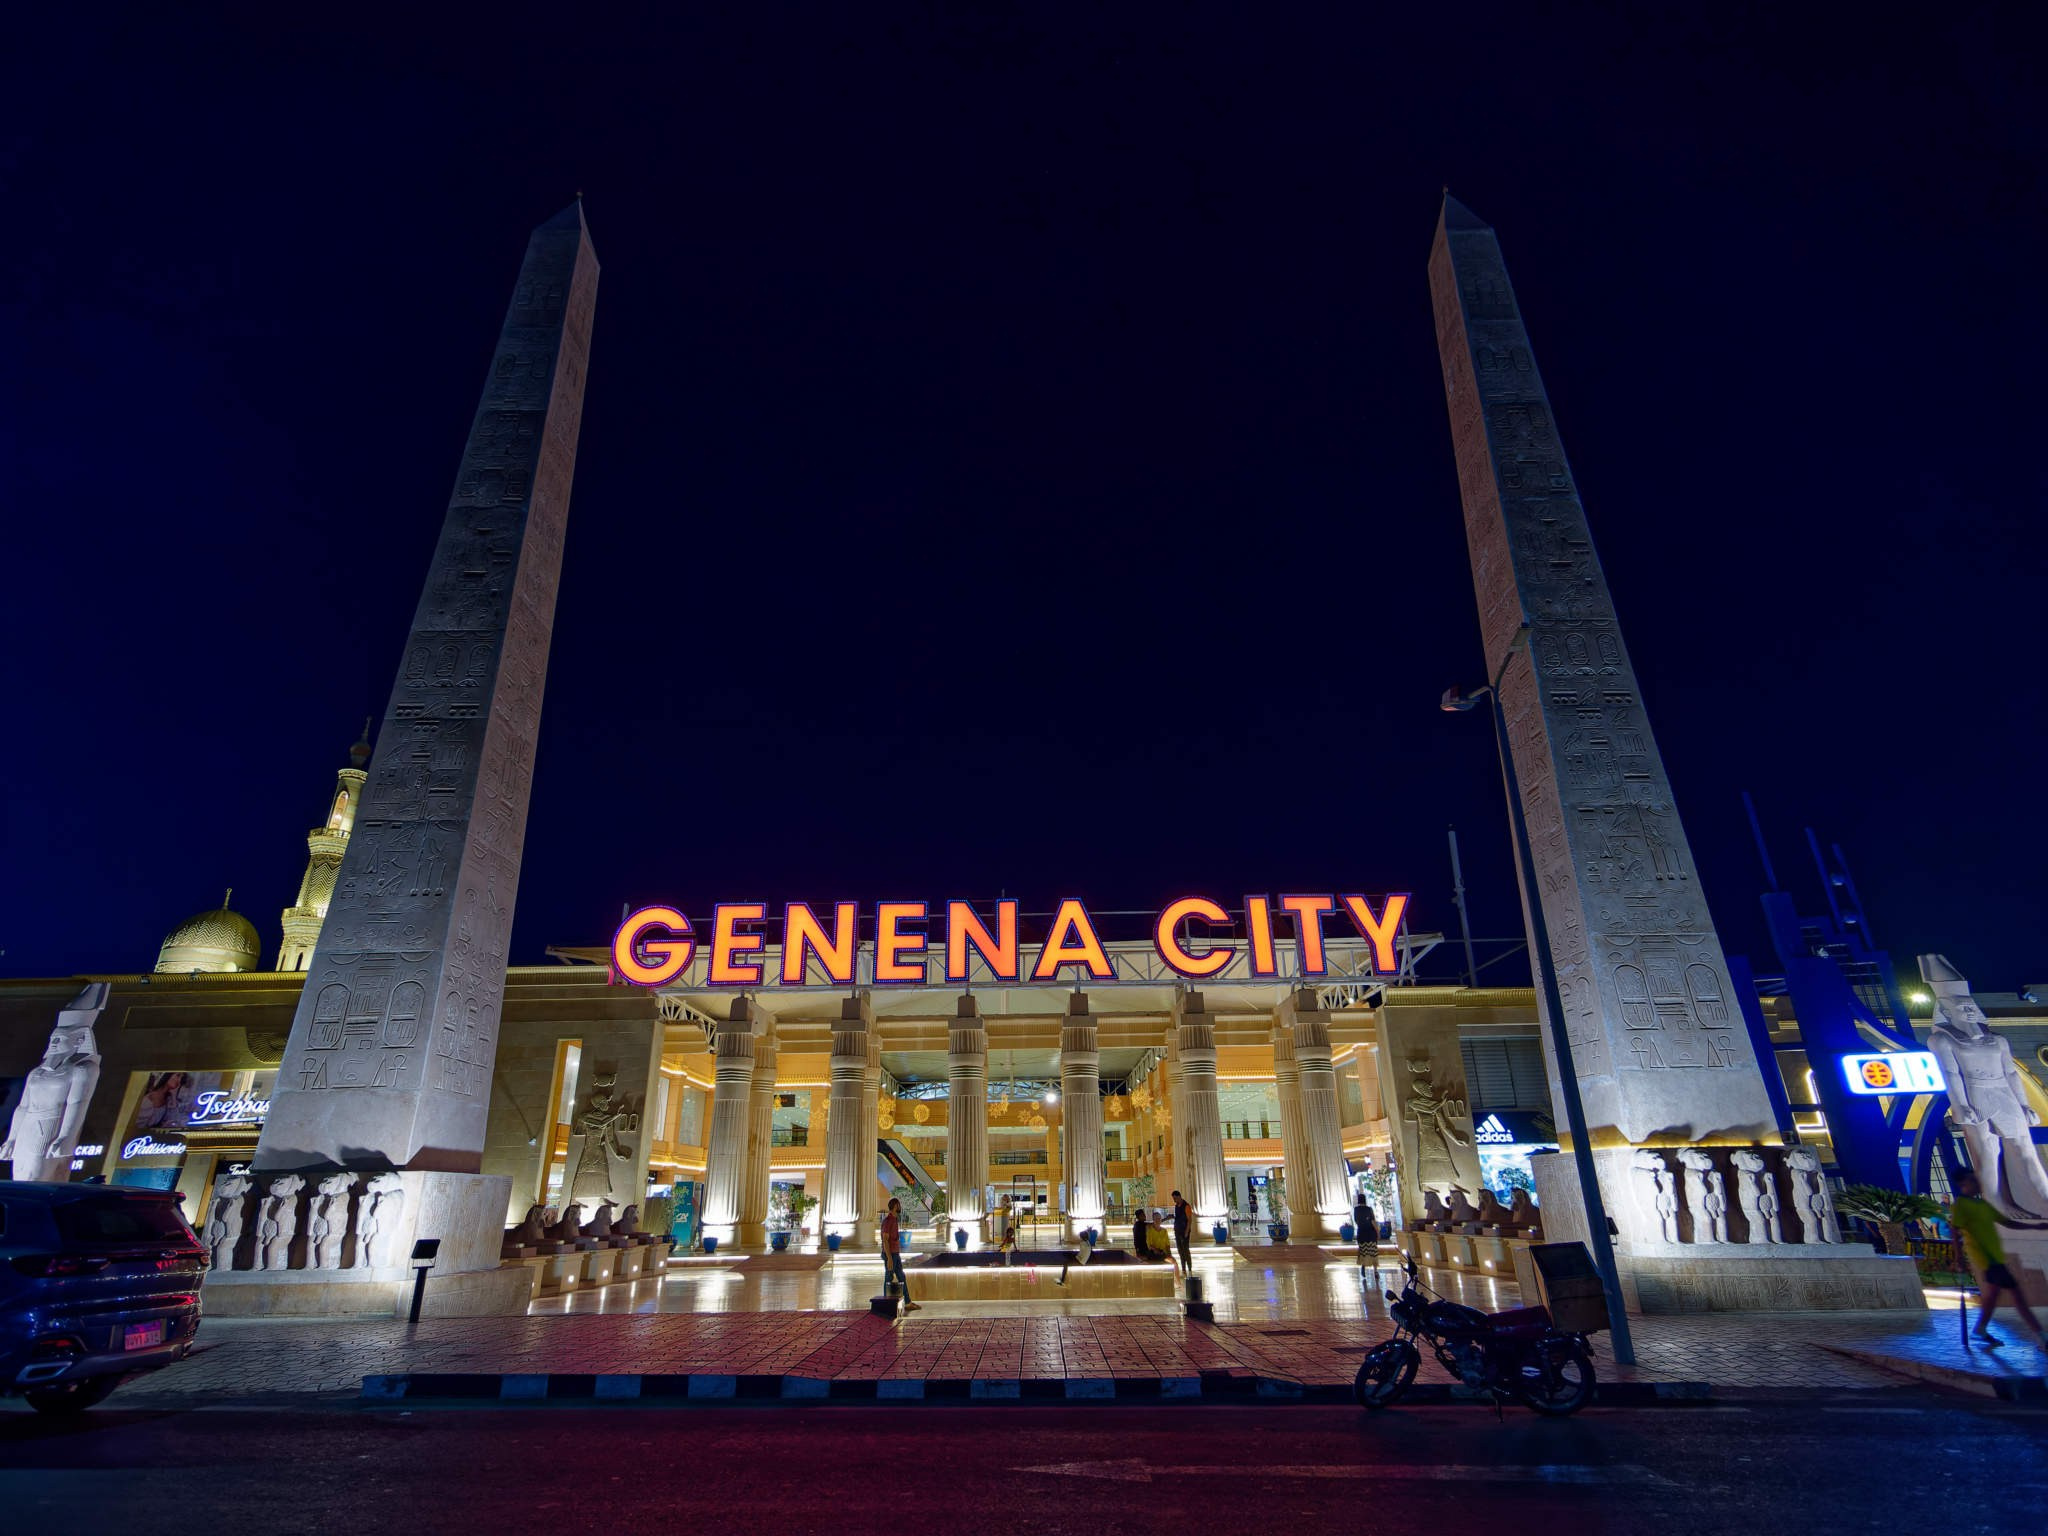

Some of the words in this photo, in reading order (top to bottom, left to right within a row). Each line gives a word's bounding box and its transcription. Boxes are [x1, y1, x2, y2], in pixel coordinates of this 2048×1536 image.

[612, 895, 1118, 987] GENENA
[1153, 892, 1412, 979] CITY
[123, 1136, 187, 1159] Patisserie
[1475, 1132, 1514, 1143] adidas
